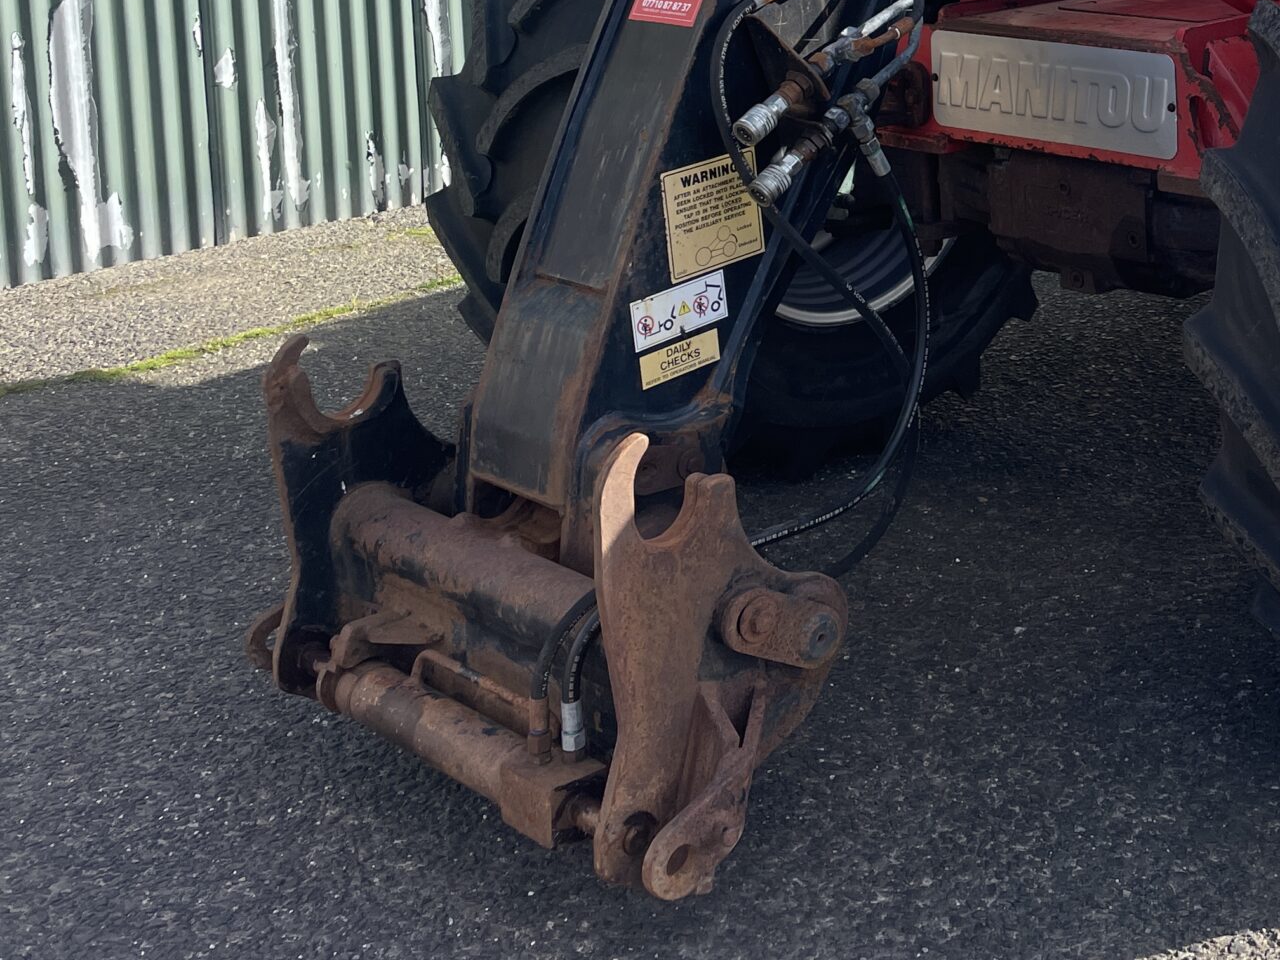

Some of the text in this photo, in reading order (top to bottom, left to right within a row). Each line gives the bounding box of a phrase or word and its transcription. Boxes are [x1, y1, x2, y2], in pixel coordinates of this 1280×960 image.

[663, 1, 673, 9] 87
[672, 2, 682, 10] 87
[682, 3, 691, 12] 37
[937, 52, 1169, 133] MANITOU
[674, 191, 691, 201] AFTER
[702, 178, 736, 192] ATTACHMENT
[676, 182, 743, 207] BEEN LOCKED INTO PLAC
[675, 201, 752, 230] POSITION BEFORE OPERATING
[676, 204, 697, 215] ENSURE
[699, 200, 712, 208] THAT
[709, 204, 720, 212] THE
[721, 197, 743, 208] LOCKED
[683, 210, 746, 235] THE AUXILIARY SERVICE
[660, 348, 701, 371] CHECKS
[666, 340, 692, 357] DAILY
[645, 377, 661, 386] REFER
